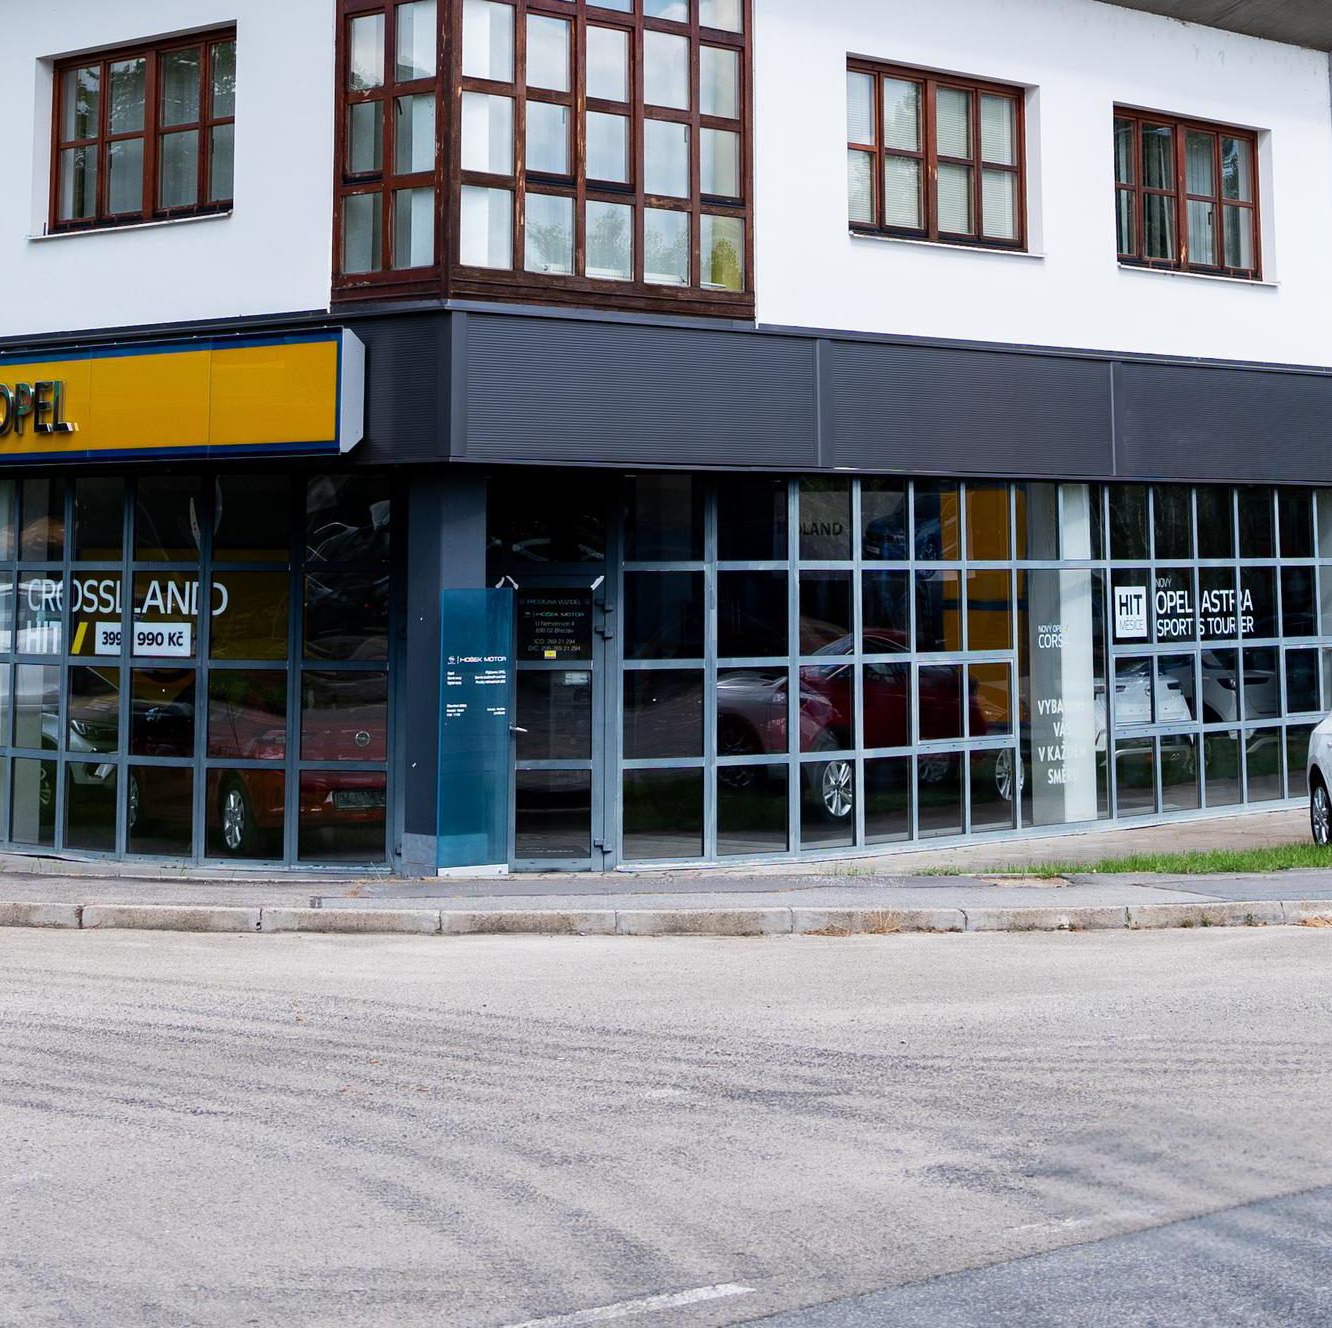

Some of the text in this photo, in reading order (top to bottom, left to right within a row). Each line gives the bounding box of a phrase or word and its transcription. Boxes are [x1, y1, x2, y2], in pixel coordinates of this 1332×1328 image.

[1155, 576, 1172, 588] NOVÝ
[27, 579, 229, 616] CROSSLAND
[1119, 594, 1142, 616] HIT
[1155, 588, 1254, 614] OPEL ASTRA
[1157, 616, 1254, 637] SPORTS TOURER
[137, 631, 164, 646] 990
[168, 630, 184, 646] Kč
[1038, 747, 1045, 762] V
